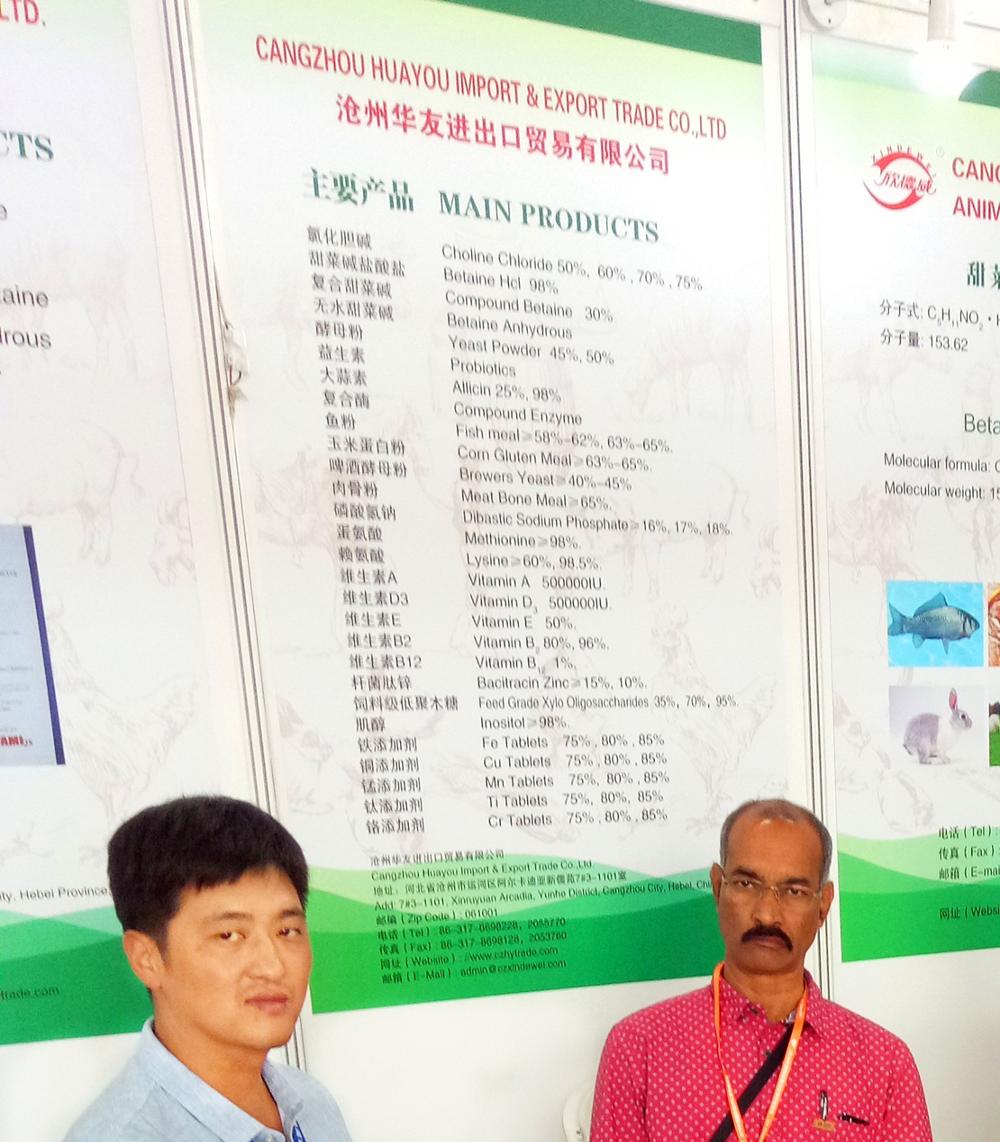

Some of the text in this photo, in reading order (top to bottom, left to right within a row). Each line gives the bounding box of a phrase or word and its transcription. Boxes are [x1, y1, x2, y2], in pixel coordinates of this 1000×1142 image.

[256, 35, 727, 140] CANGZHOU HUAYOU IMPORT & EXPORT TRADE CO.,LTD
[336, 93, 669, 175] 沧州华友进出口贸易有限公司
[303, 167, 659, 243] 主要产品 MAIN PRODUCTS
[441, 244, 493, 265] Choline
[498, 251, 553, 272] Chloride
[443, 267, 495, 287] Betaine
[529, 278, 559, 295] 98%
[445, 290, 614, 323] Compound Betaine 30%
[447, 312, 573, 339] Betaine Anhydrous
[449, 334, 542, 358] Yeast Powder
[928, 334, 968, 352] 153.62
[450, 357, 516, 377] Probiotics
[452, 380, 491, 397] Allicin
[454, 401, 582, 426] Compound Enzyme
[456, 424, 484, 440] Fish
[457, 445, 537, 466] Corn Gluten
[884, 452, 991, 473] Molecular formula:
[459, 467, 514, 484] Brewers
[461, 488, 532, 507] Meat Bone
[884, 480, 942, 497] Molecular
[945, 485, 985, 502] weight:
[516, 513, 562, 529] Sodium
[468, 574, 517, 588] Vitamin
[470, 594, 518, 609] Vitamin
[472, 615, 533, 629] Vitamin E
[473, 635, 522, 650] Vitamin
[475, 656, 524, 670] Vitamin
[477, 676, 540, 690] Bacitracin
[478, 696, 649, 712] Feed Grade Xylo Oligosaccharides
[482, 736, 498, 749] Fe
[504, 736, 549, 749] Tablets
[638, 733, 665, 747] 85%
[483, 752, 668, 769] Cu Tablets 85%
[485, 776, 554, 789] Mn Tablets
[503, 795, 548, 808] Tablets
[488, 814, 553, 828] Cr Tablets
